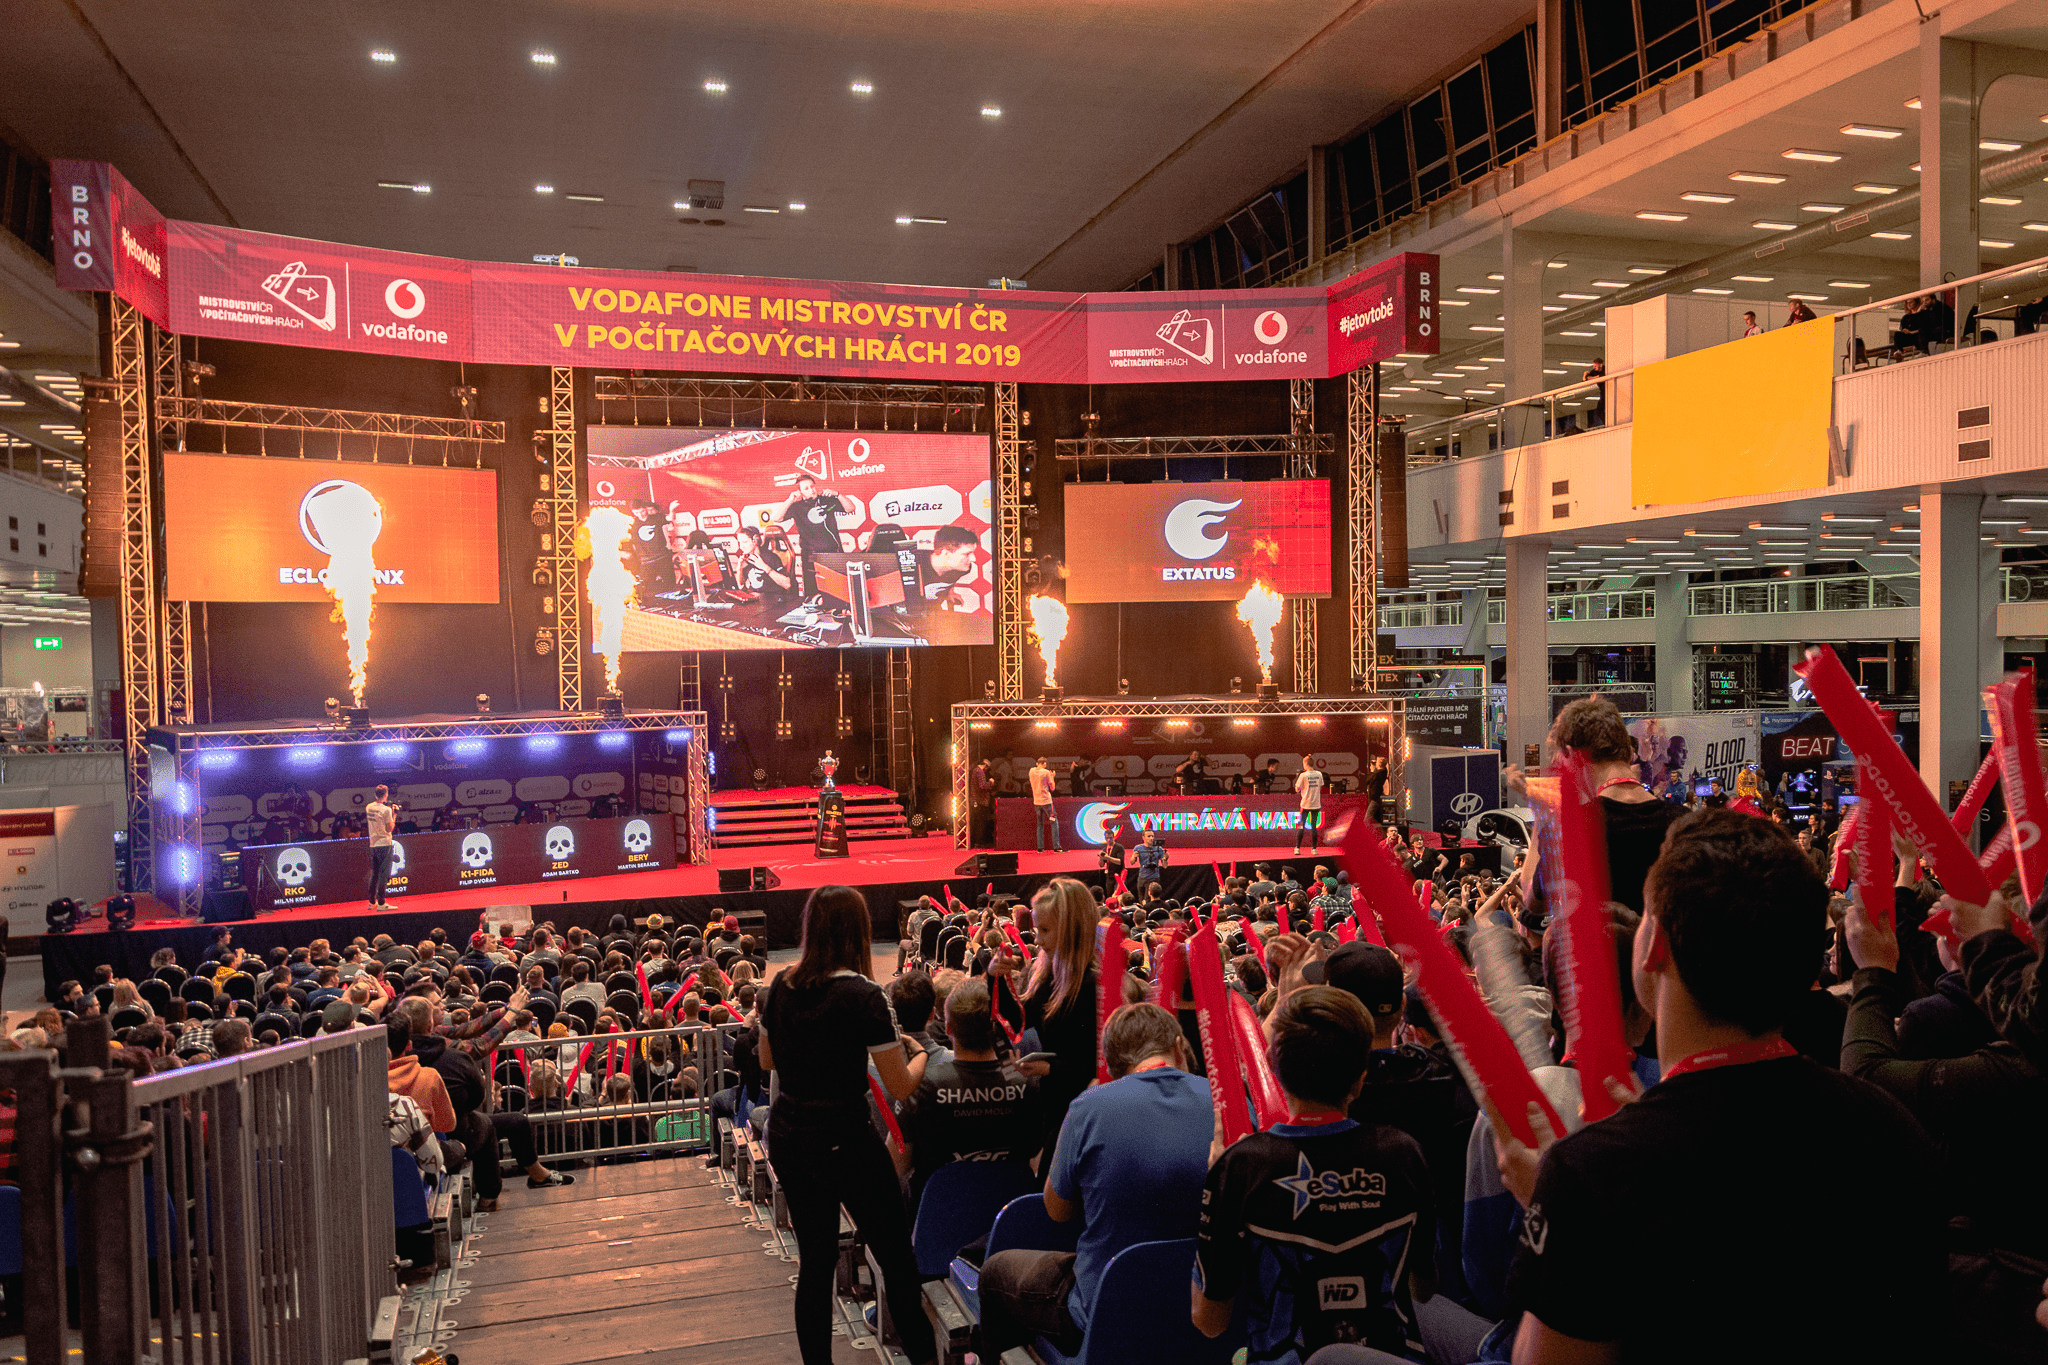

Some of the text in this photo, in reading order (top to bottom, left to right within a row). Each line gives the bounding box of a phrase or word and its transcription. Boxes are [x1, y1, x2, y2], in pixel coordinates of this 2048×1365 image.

[72, 185, 93, 269] BRNO
[121, 225, 161, 279] #jetovtobě
[568, 286, 1007, 332] VODAFONE MISTROVSTVÍ ČR
[1419, 271, 1431, 337] BRNO
[1339, 297, 1394, 337] #jetovtobě
[362, 322, 448, 345] vodafone
[554, 322, 1021, 367] V POČÍTAČOVÝCH HRÁCH 2019
[1235, 350, 1307, 365] vodafone
[838, 463, 885, 478] vodafone
[589, 498, 626, 506] vodafone
[904, 500, 943, 513] alza.cz
[279, 567, 328, 584] ECLO
[1162, 567, 1235, 581] EXTATUS
[1446, 712, 1468, 720] HRÁCH
[1455, 704, 1469, 712] MČR
[1705, 737, 1746, 769] BLOOD
[1781, 736, 1835, 758] BEAT
[1129, 807, 1250, 832] VYHRÁVÁ
[551, 861, 569, 870] ZED
[628, 853, 649, 862] BERY
[460, 868, 494, 878] K1-FIDA
[284, 886, 306, 896] RKO
[936, 1083, 1027, 1104] SHANOBY
[953, 1108, 983, 1118] DAVID
[1306, 1168, 1386, 1198] eSuba
[1318, 1200, 1381, 1213] Play With Soul
[1323, 1283, 1359, 1303] WD
